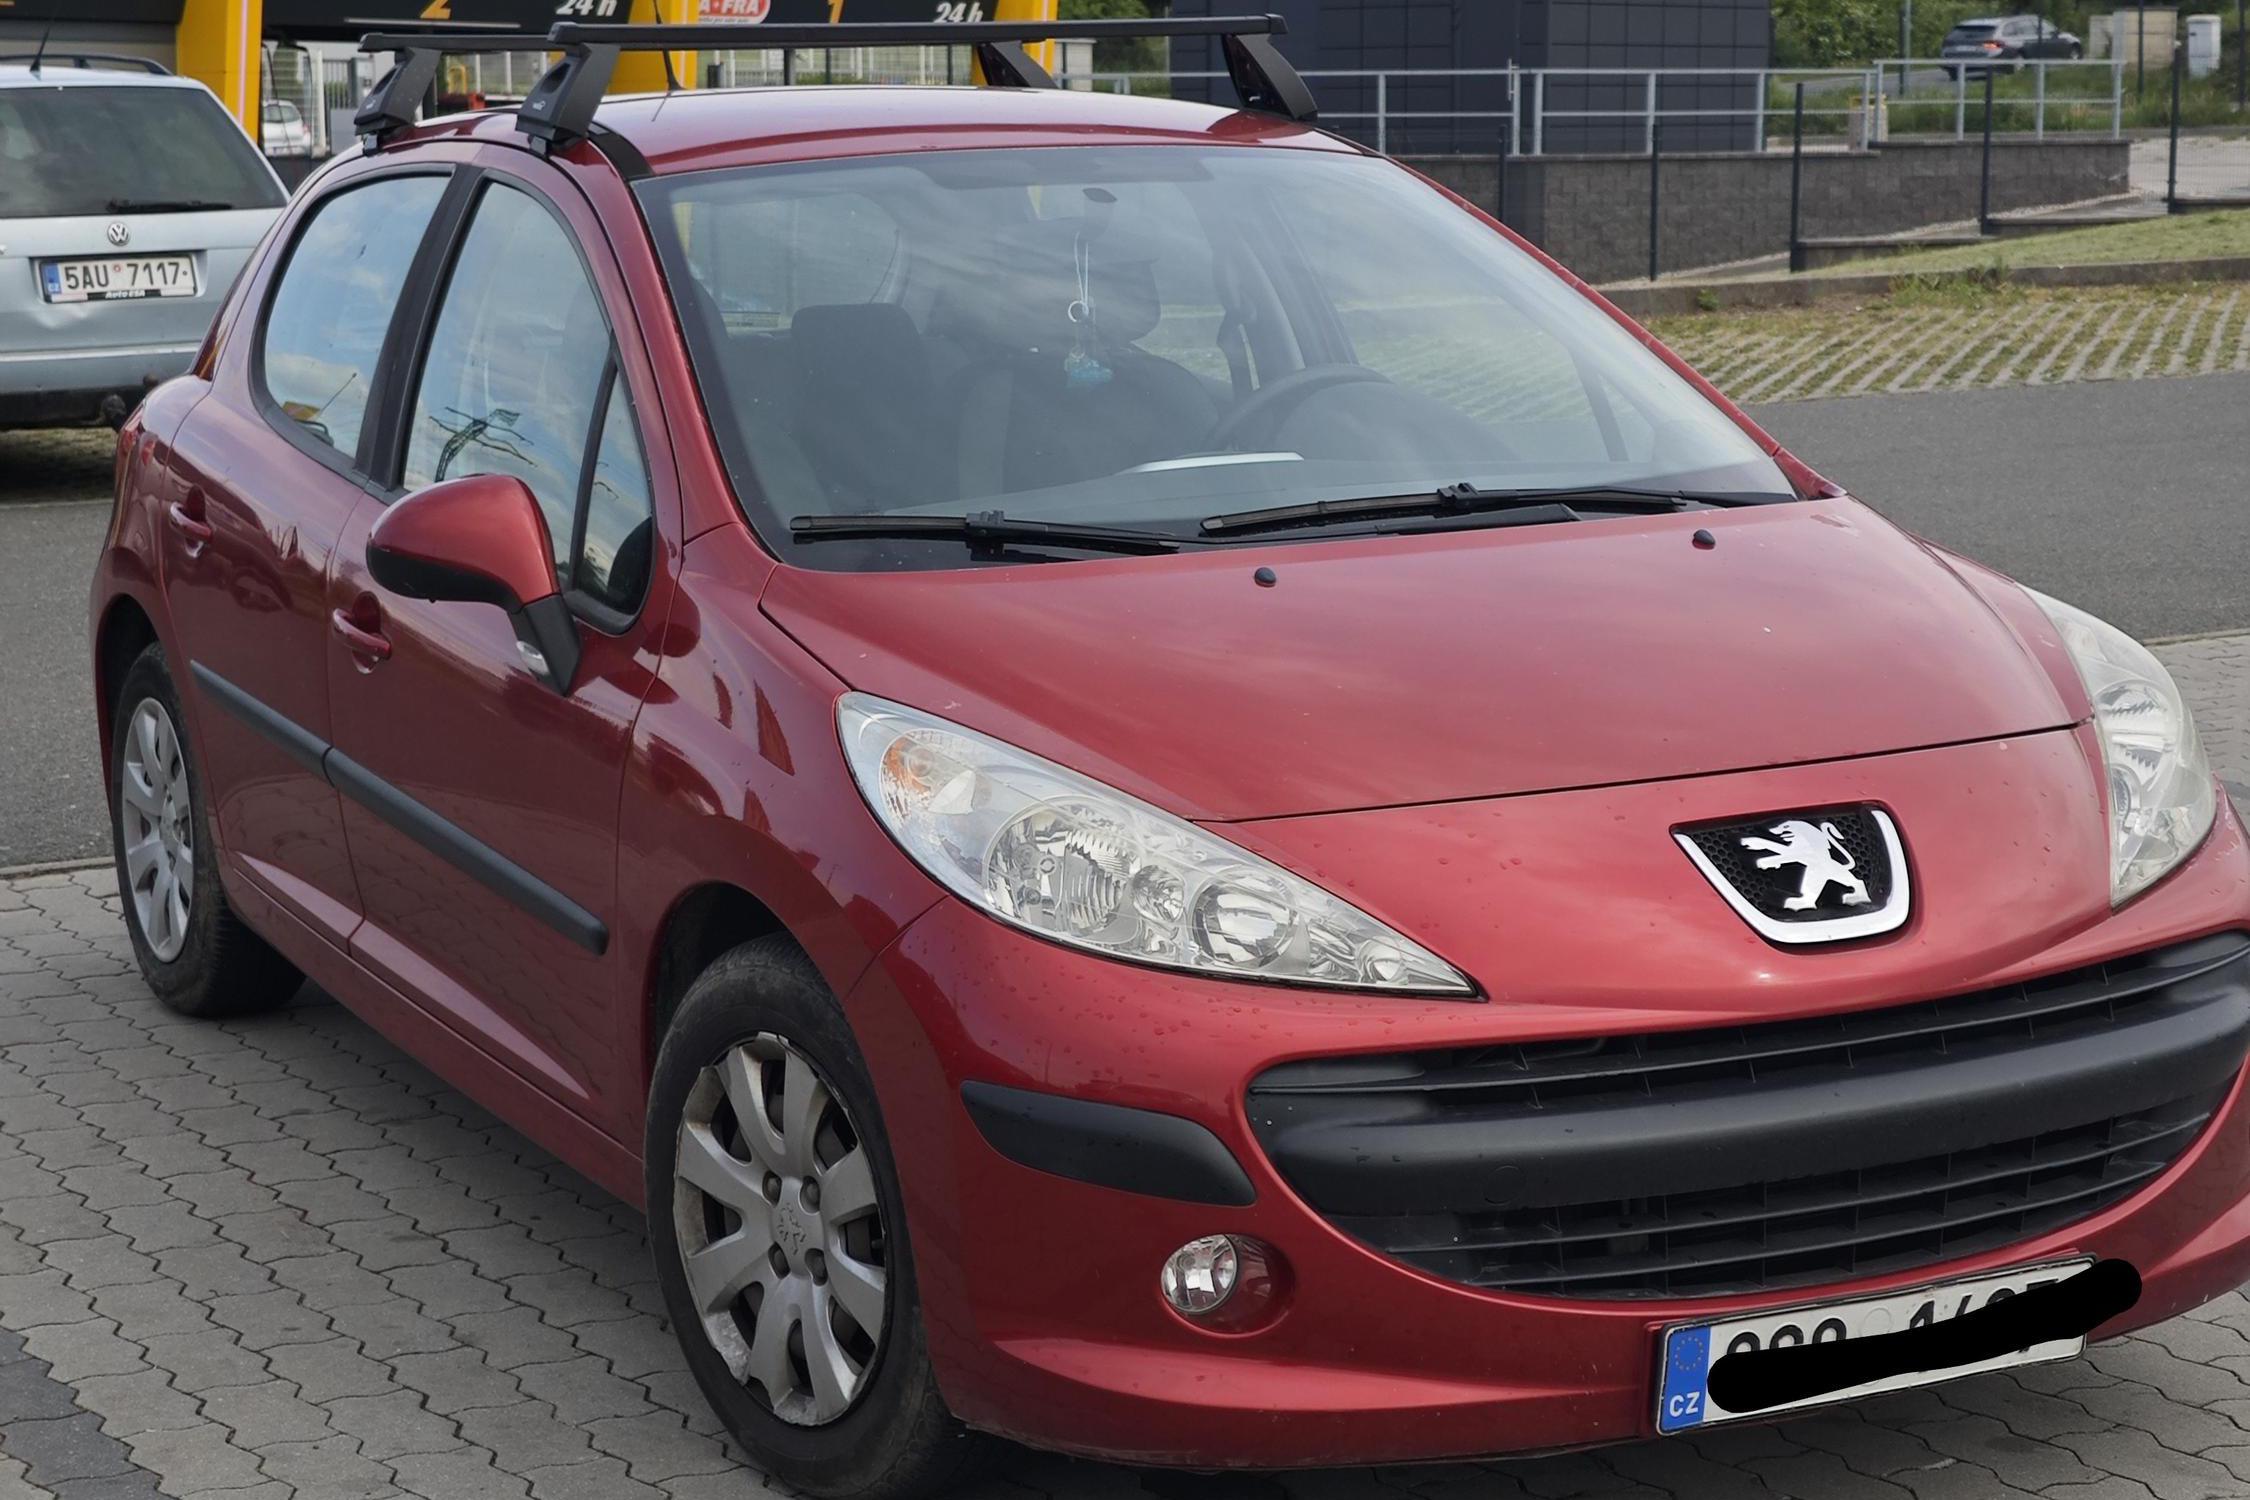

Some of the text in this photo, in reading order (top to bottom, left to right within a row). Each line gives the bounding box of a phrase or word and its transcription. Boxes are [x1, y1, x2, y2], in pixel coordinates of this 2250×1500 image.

[64, 262, 179, 289] 5AU 7117
[1669, 1391, 1700, 1418] CZ
